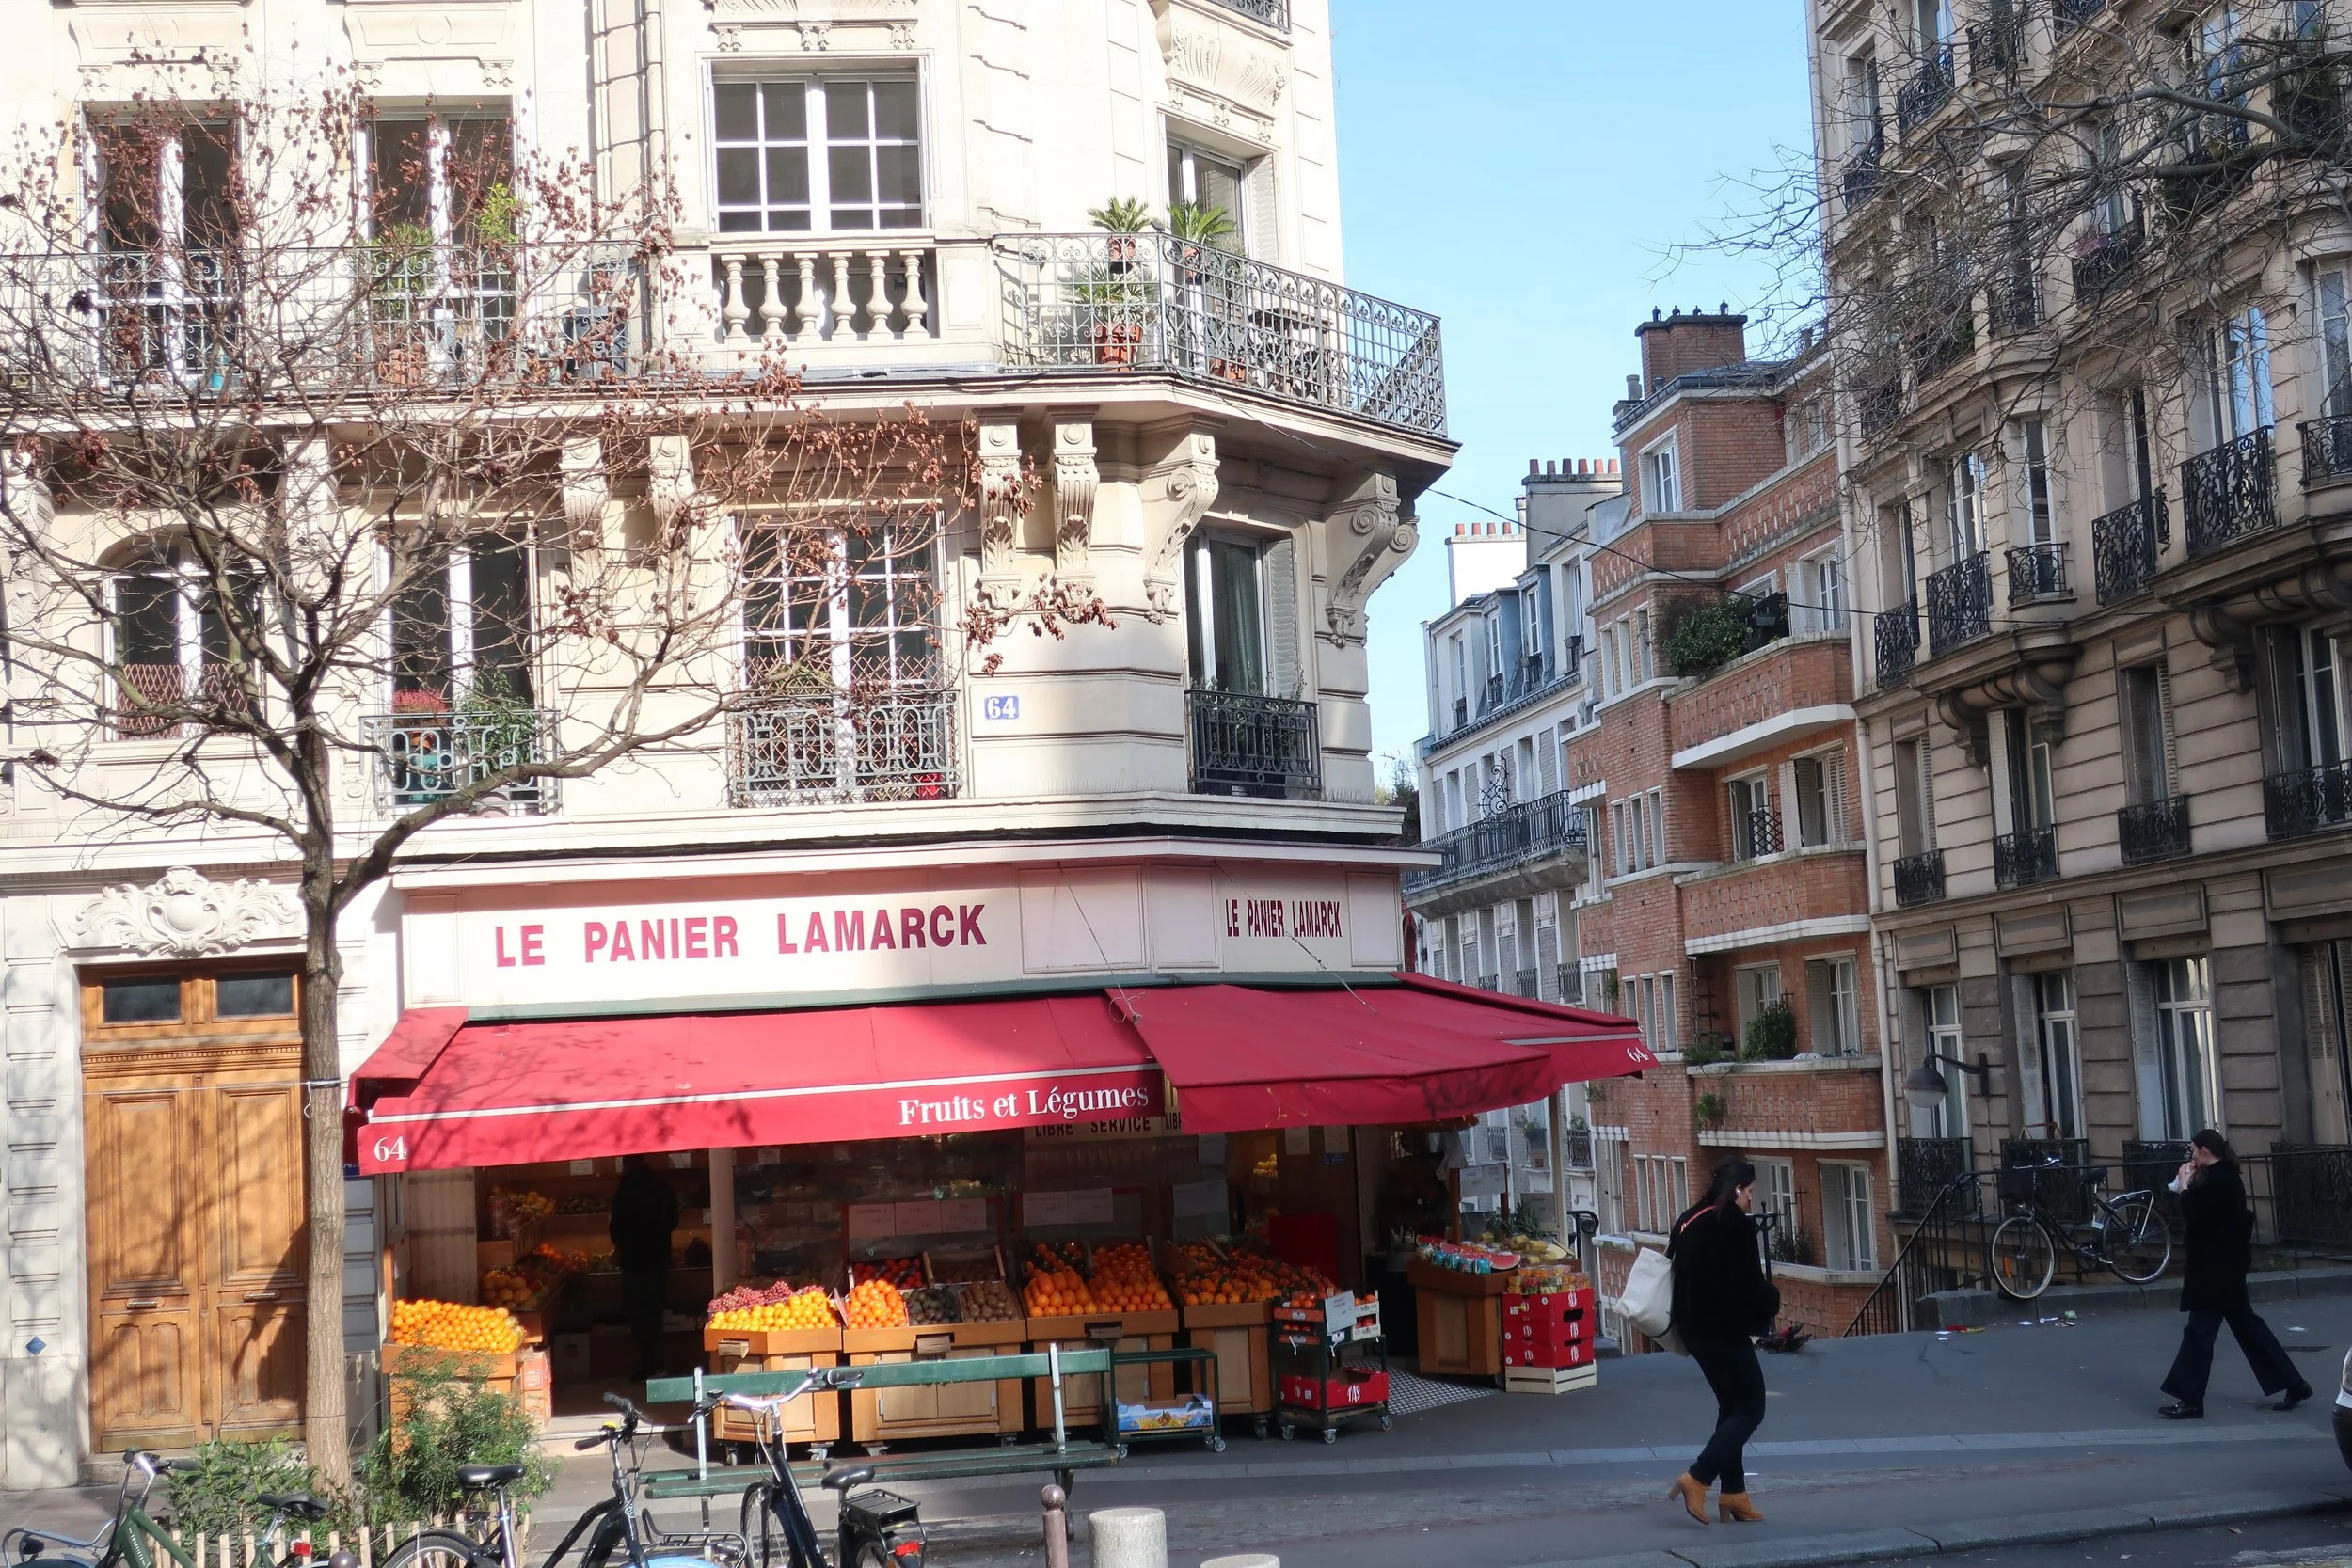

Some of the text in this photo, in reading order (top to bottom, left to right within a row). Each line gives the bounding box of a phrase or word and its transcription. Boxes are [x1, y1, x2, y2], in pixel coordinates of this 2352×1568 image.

[987, 697, 1016, 719] 64
[1226, 899, 1342, 938] LE PANIER LAMARCK
[495, 904, 987, 968] LE PANIER LAMARCK
[1627, 1046, 1650, 1063] 64
[898, 1086, 1149, 1125] Fruits et Légumes
[1036, 1117, 1151, 1137] LIBRE SERVICE
[373, 1135, 407, 1162] 64
